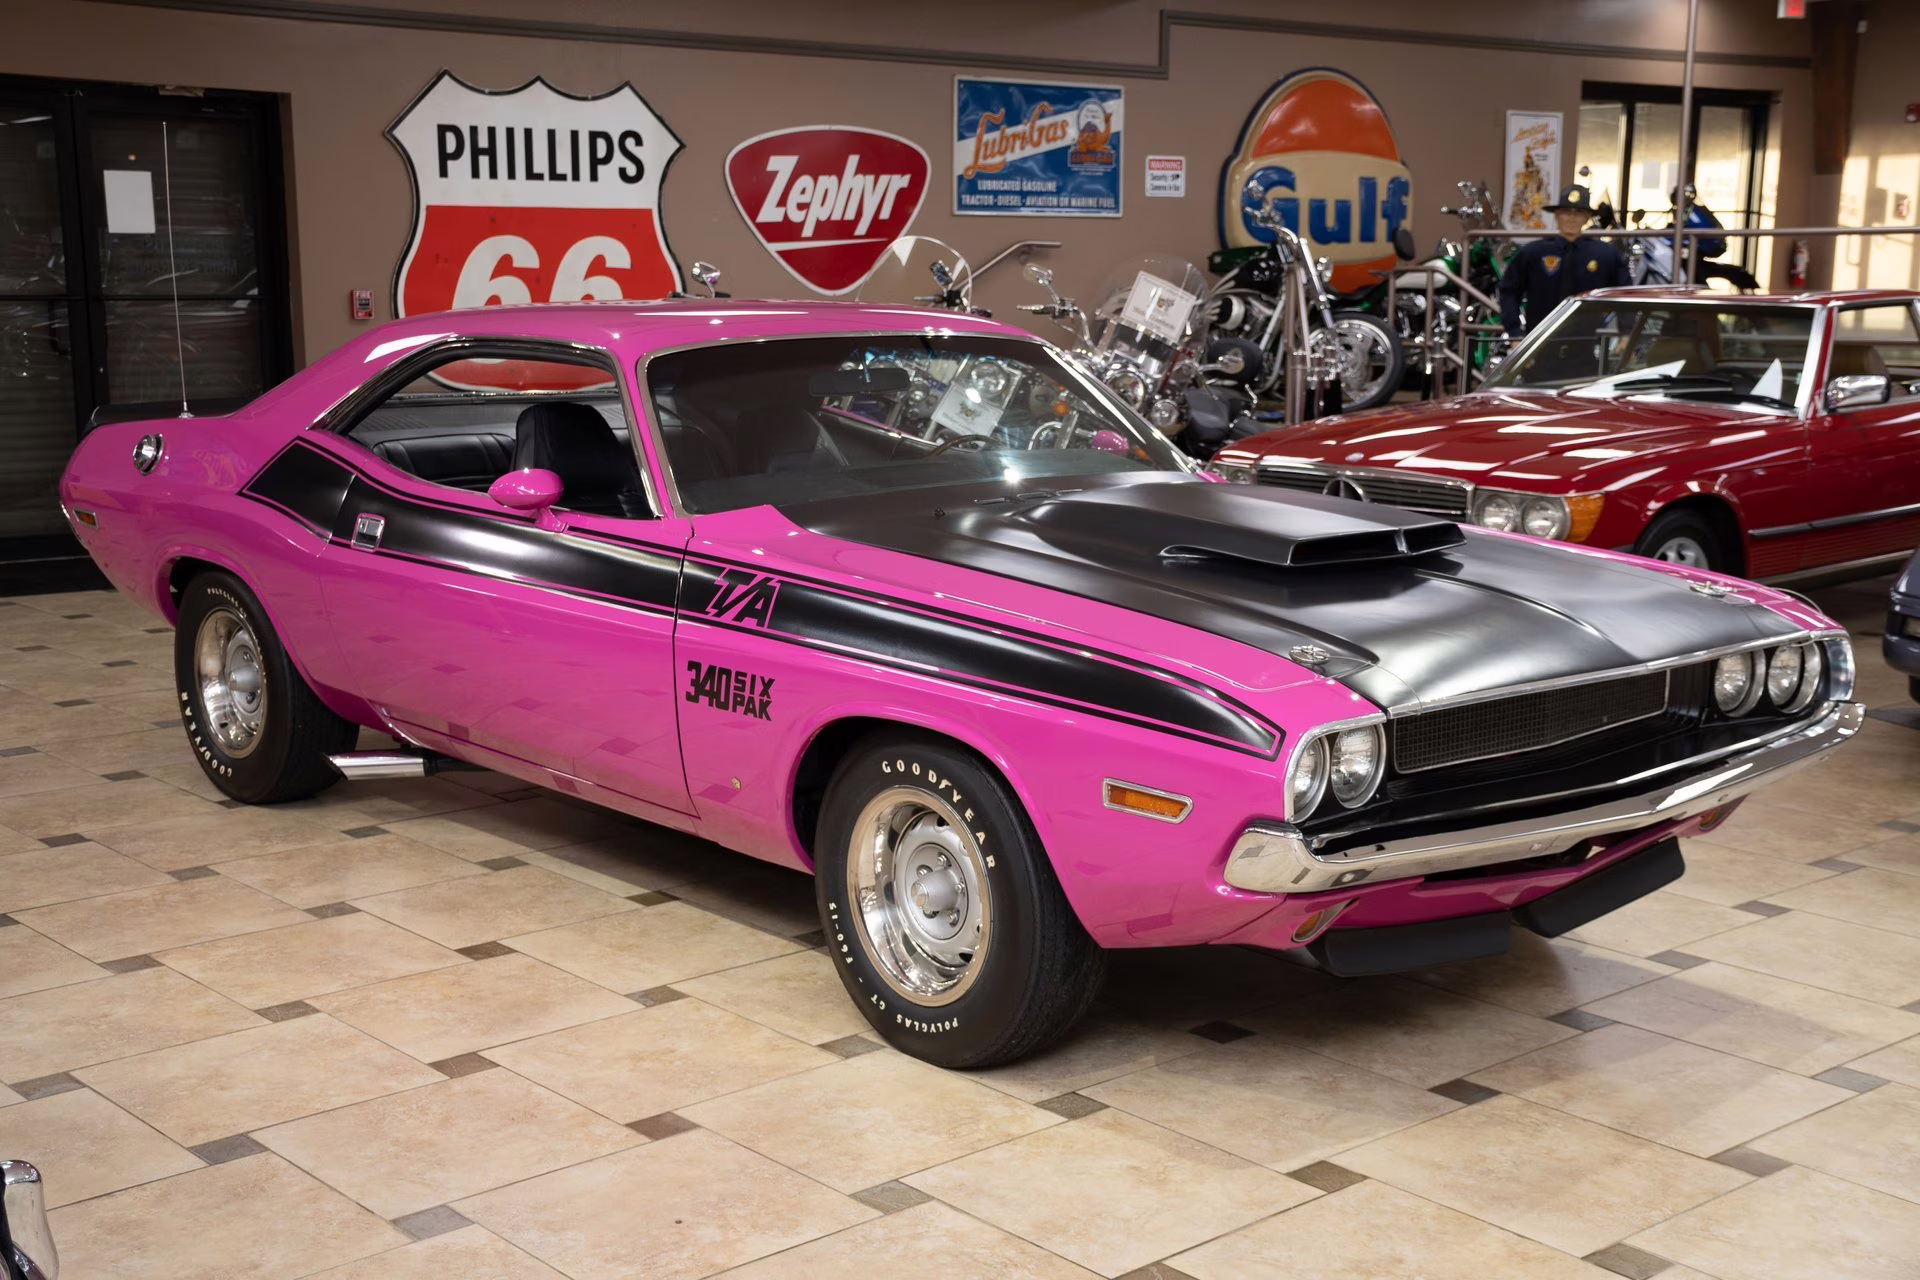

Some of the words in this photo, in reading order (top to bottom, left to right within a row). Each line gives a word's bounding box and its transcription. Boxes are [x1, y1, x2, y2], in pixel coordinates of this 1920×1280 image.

[437, 123, 645, 184] PHILLIPS
[755, 154, 911, 238] Zephyr
[977, 179, 1021, 191] LUBRICATED
[1022, 180, 1057, 192] GASOLINE
[1242, 166, 1410, 245] Gulf
[706, 567, 781, 629] T/A
[685, 660, 732, 711] 340
[733, 670, 776, 700] SIX
[732, 692, 773, 722] PAK
[181, 691, 233, 778] GOODYEAR
[882, 759, 996, 868] GOODYEAR
[871, 994, 886, 1010] GT
[896, 1013, 959, 1034] POLYGLAS
